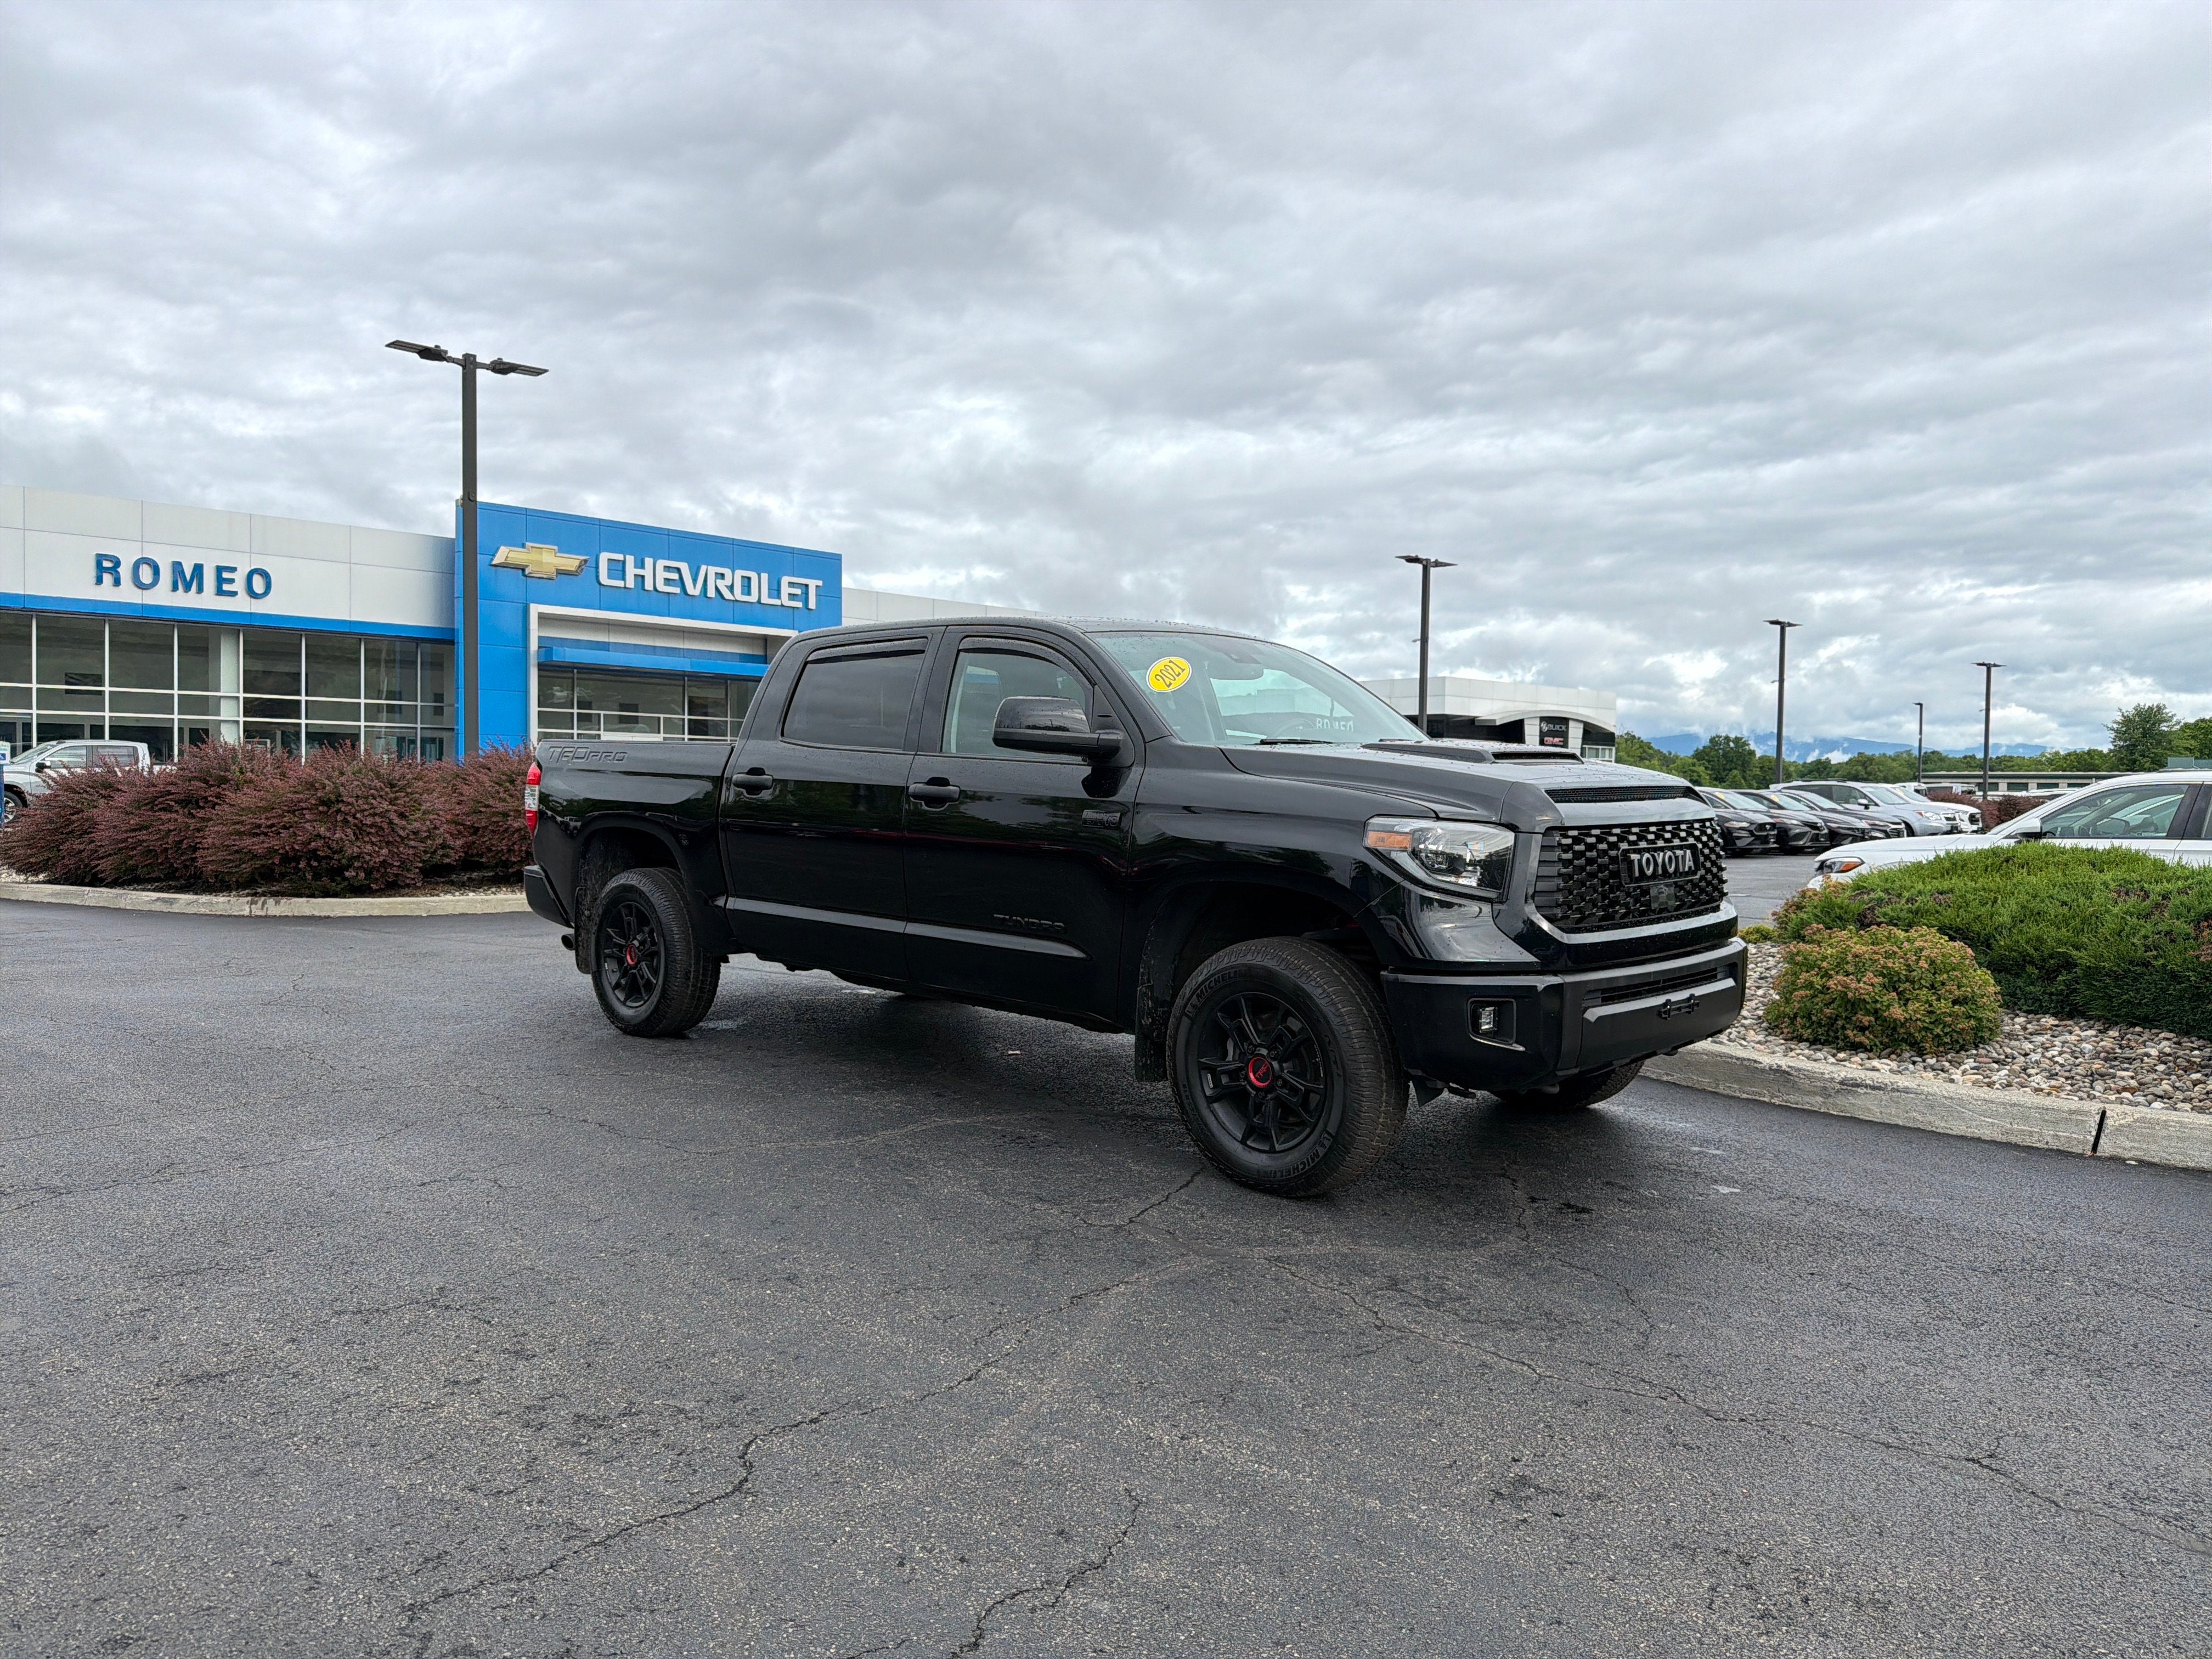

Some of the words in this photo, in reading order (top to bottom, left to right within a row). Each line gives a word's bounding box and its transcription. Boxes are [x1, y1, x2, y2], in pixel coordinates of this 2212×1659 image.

[94, 552, 273, 599] ROMEO
[598, 551, 823, 610] CHEVROLET
[1154, 659, 1186, 689] 2021
[1543, 737, 1564, 746] GMC
[1104, 813, 1121, 827] V8
[1627, 849, 1695, 877] TOYOTA
[1195, 969, 1249, 1003] MICHELI
